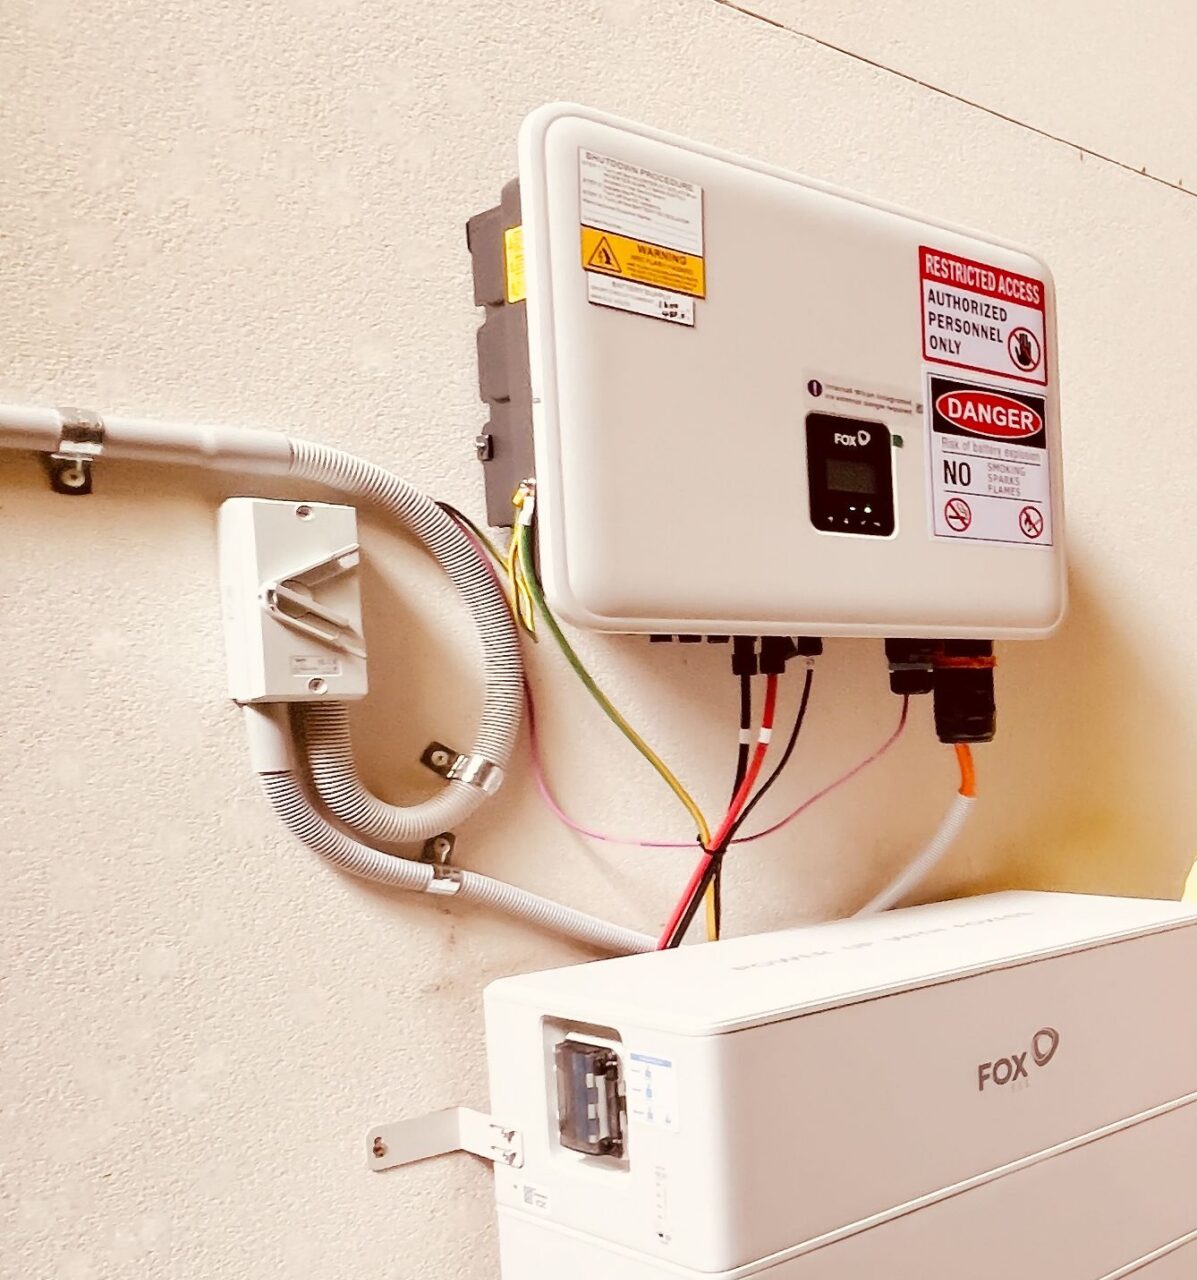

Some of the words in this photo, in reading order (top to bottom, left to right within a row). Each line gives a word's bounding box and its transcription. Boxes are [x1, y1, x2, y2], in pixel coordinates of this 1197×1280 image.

[585, 152, 638, 174] SHUTDOWN
[640, 169, 694, 192] PROCEDURE
[638, 244, 687, 265] WARNING
[925, 253, 996, 291] RESTRICTED
[998, 275, 1040, 304] ACCESS
[928, 288, 1008, 322] AUTHORIZED
[928, 312, 1003, 343] PERSONNEL
[929, 335, 961, 355] ONLY
[948, 397, 1035, 431] DANGER
[834, 432, 857, 446] FOX
[942, 437, 959, 448] Risk
[962, 441, 971, 451] of
[973, 443, 1001, 456] battery
[943, 459, 971, 486] NO
[987, 462, 1026, 477] SMOKING
[987, 474, 1020, 486] SPARKS
[987, 486, 1021, 497] FLAMES
[978, 1051, 1028, 1090] FOX
